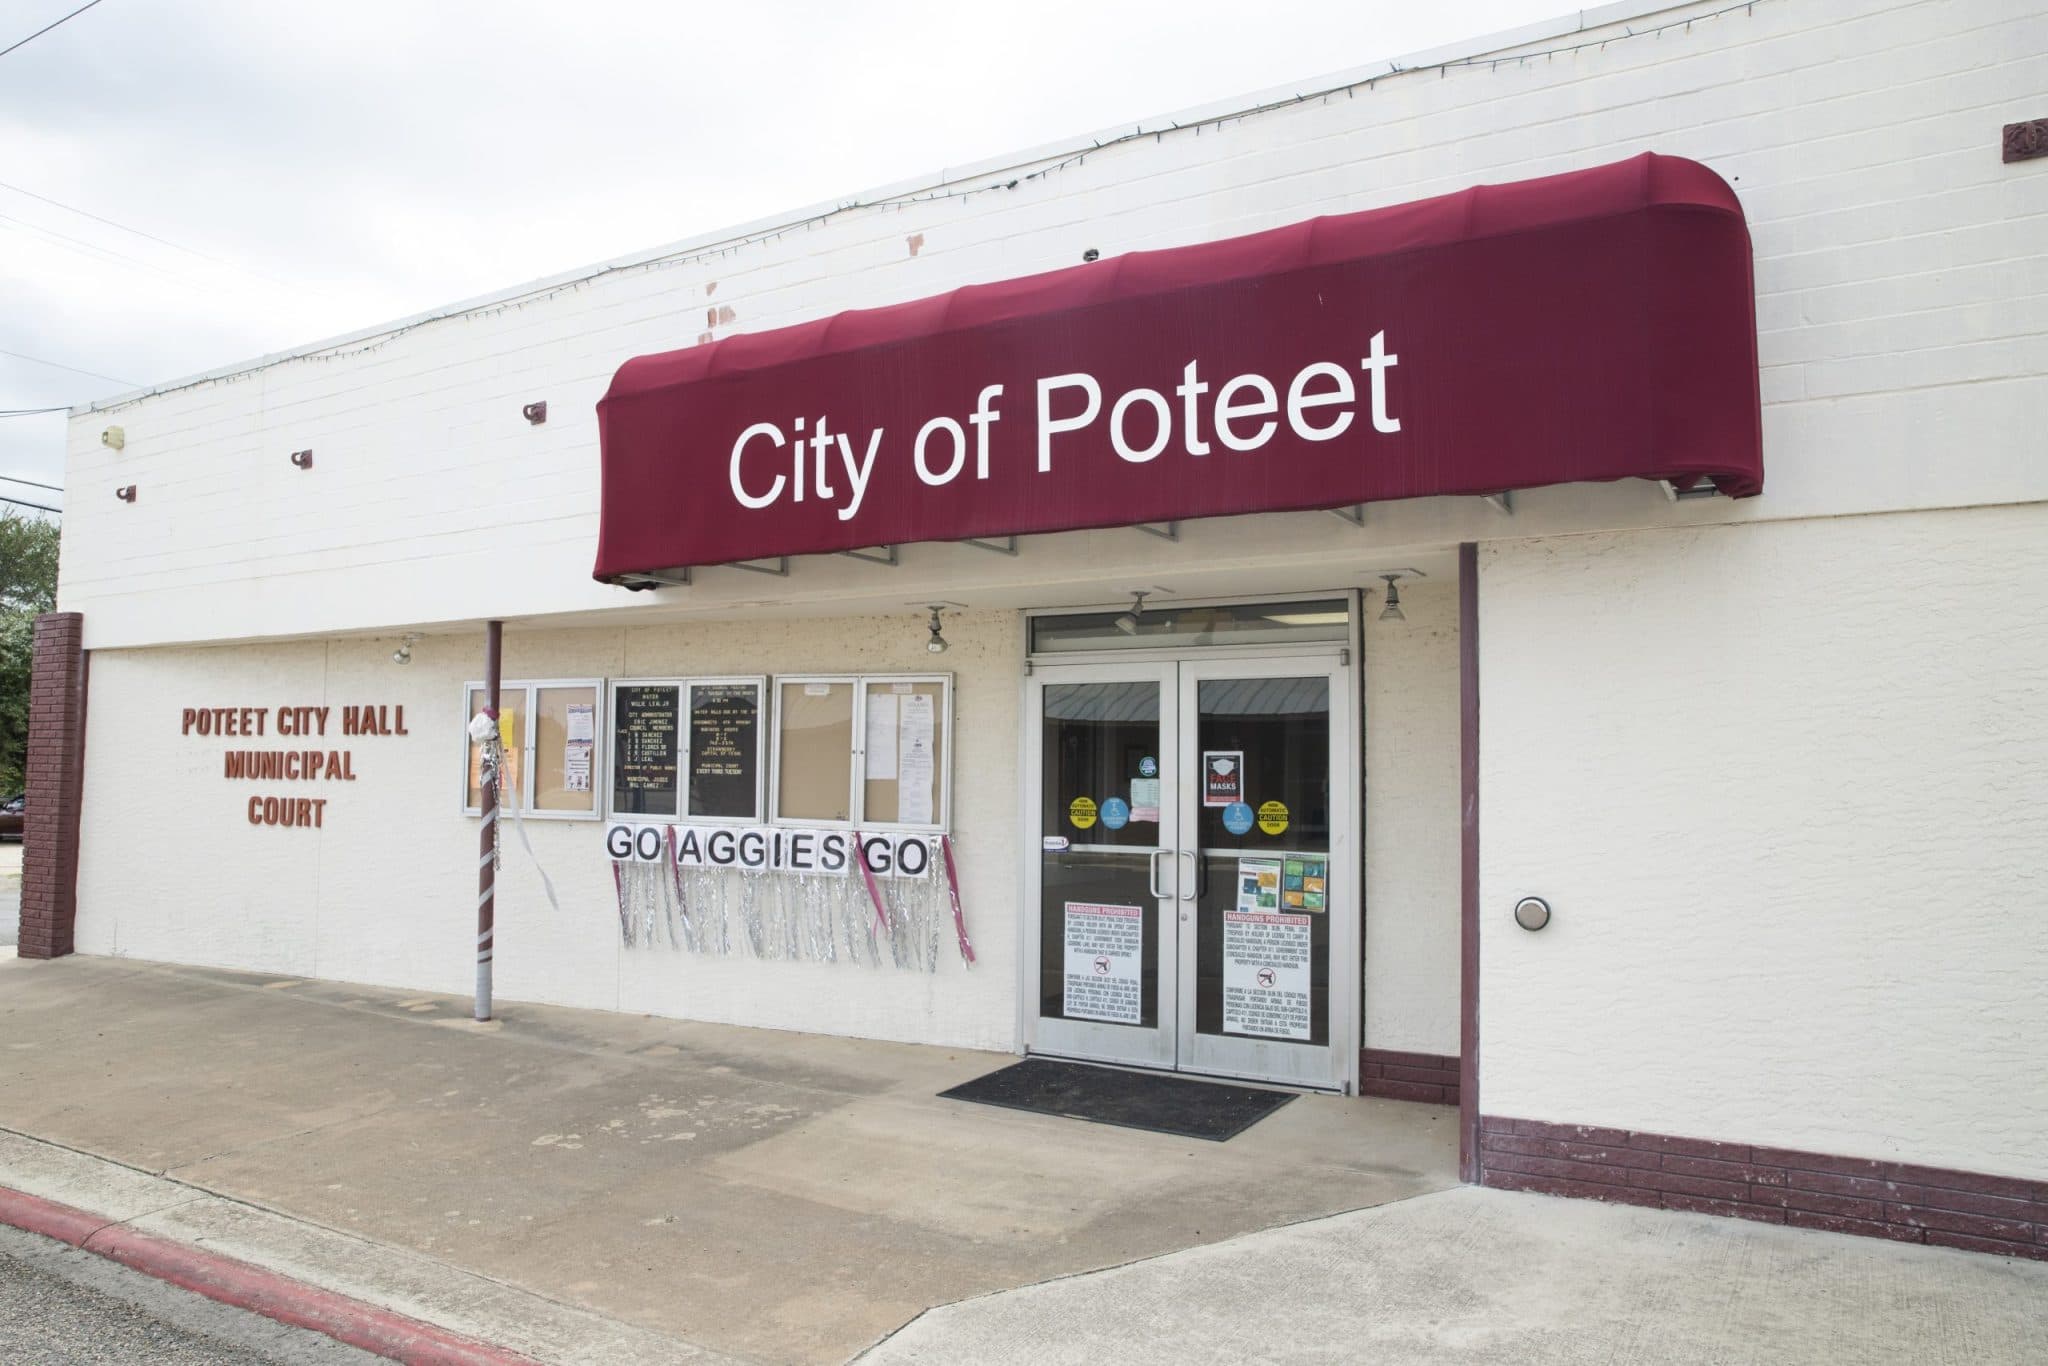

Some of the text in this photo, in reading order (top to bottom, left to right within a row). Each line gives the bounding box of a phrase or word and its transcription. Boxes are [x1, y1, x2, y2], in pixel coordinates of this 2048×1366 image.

[729, 329, 1401, 521] City of Poteet
[182, 705, 408, 736] POTEET CITY HALL
[225, 750, 356, 781] MUNICIPAL
[248, 796, 326, 828] COURT
[606, 826, 928, 875] GO AGGIES GO
[1068, 905, 1139, 916] HANDGUNS PROHIBITED
[1227, 913, 1307, 924] HANDGUNS PROHIBITED
